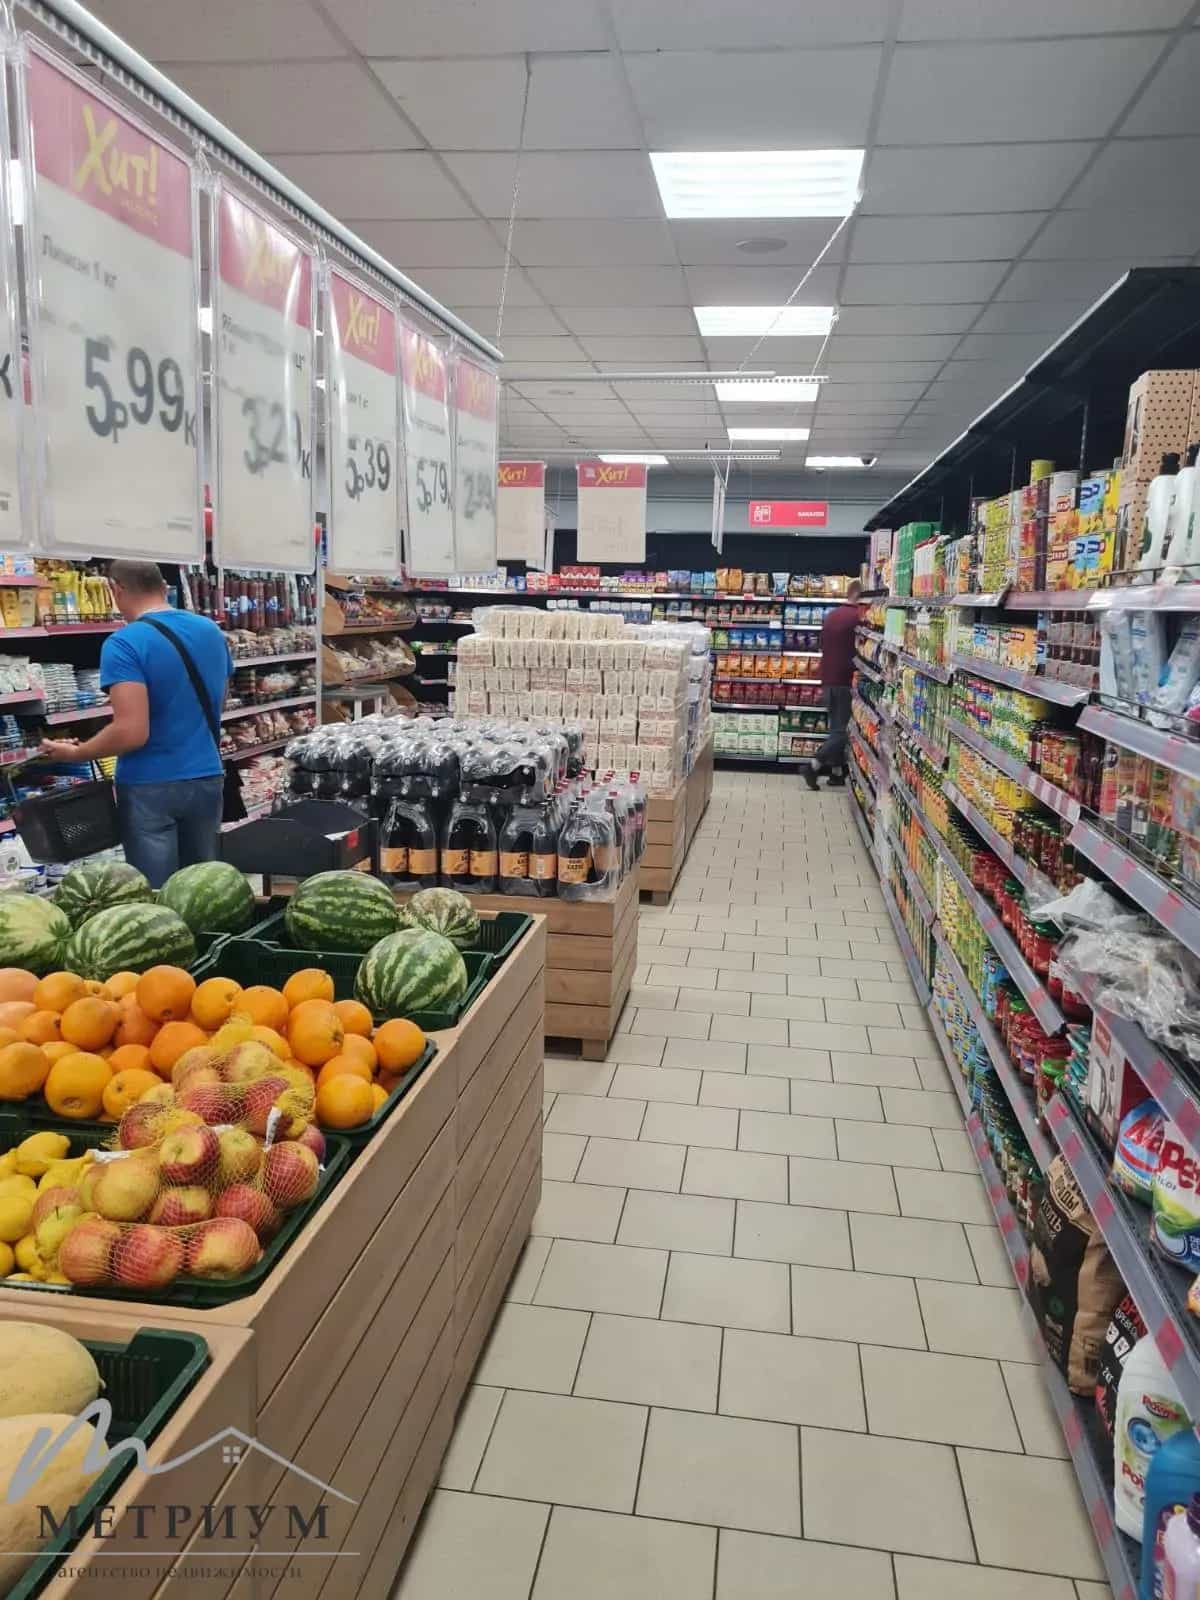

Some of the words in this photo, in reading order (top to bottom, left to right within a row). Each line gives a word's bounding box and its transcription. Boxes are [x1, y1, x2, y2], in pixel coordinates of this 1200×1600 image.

[75, 104, 159, 206] Хит!
[343, 297, 381, 349] Хит!
[497, 467, 527, 484] Хит!
[595, 464, 628, 485] Хит!
